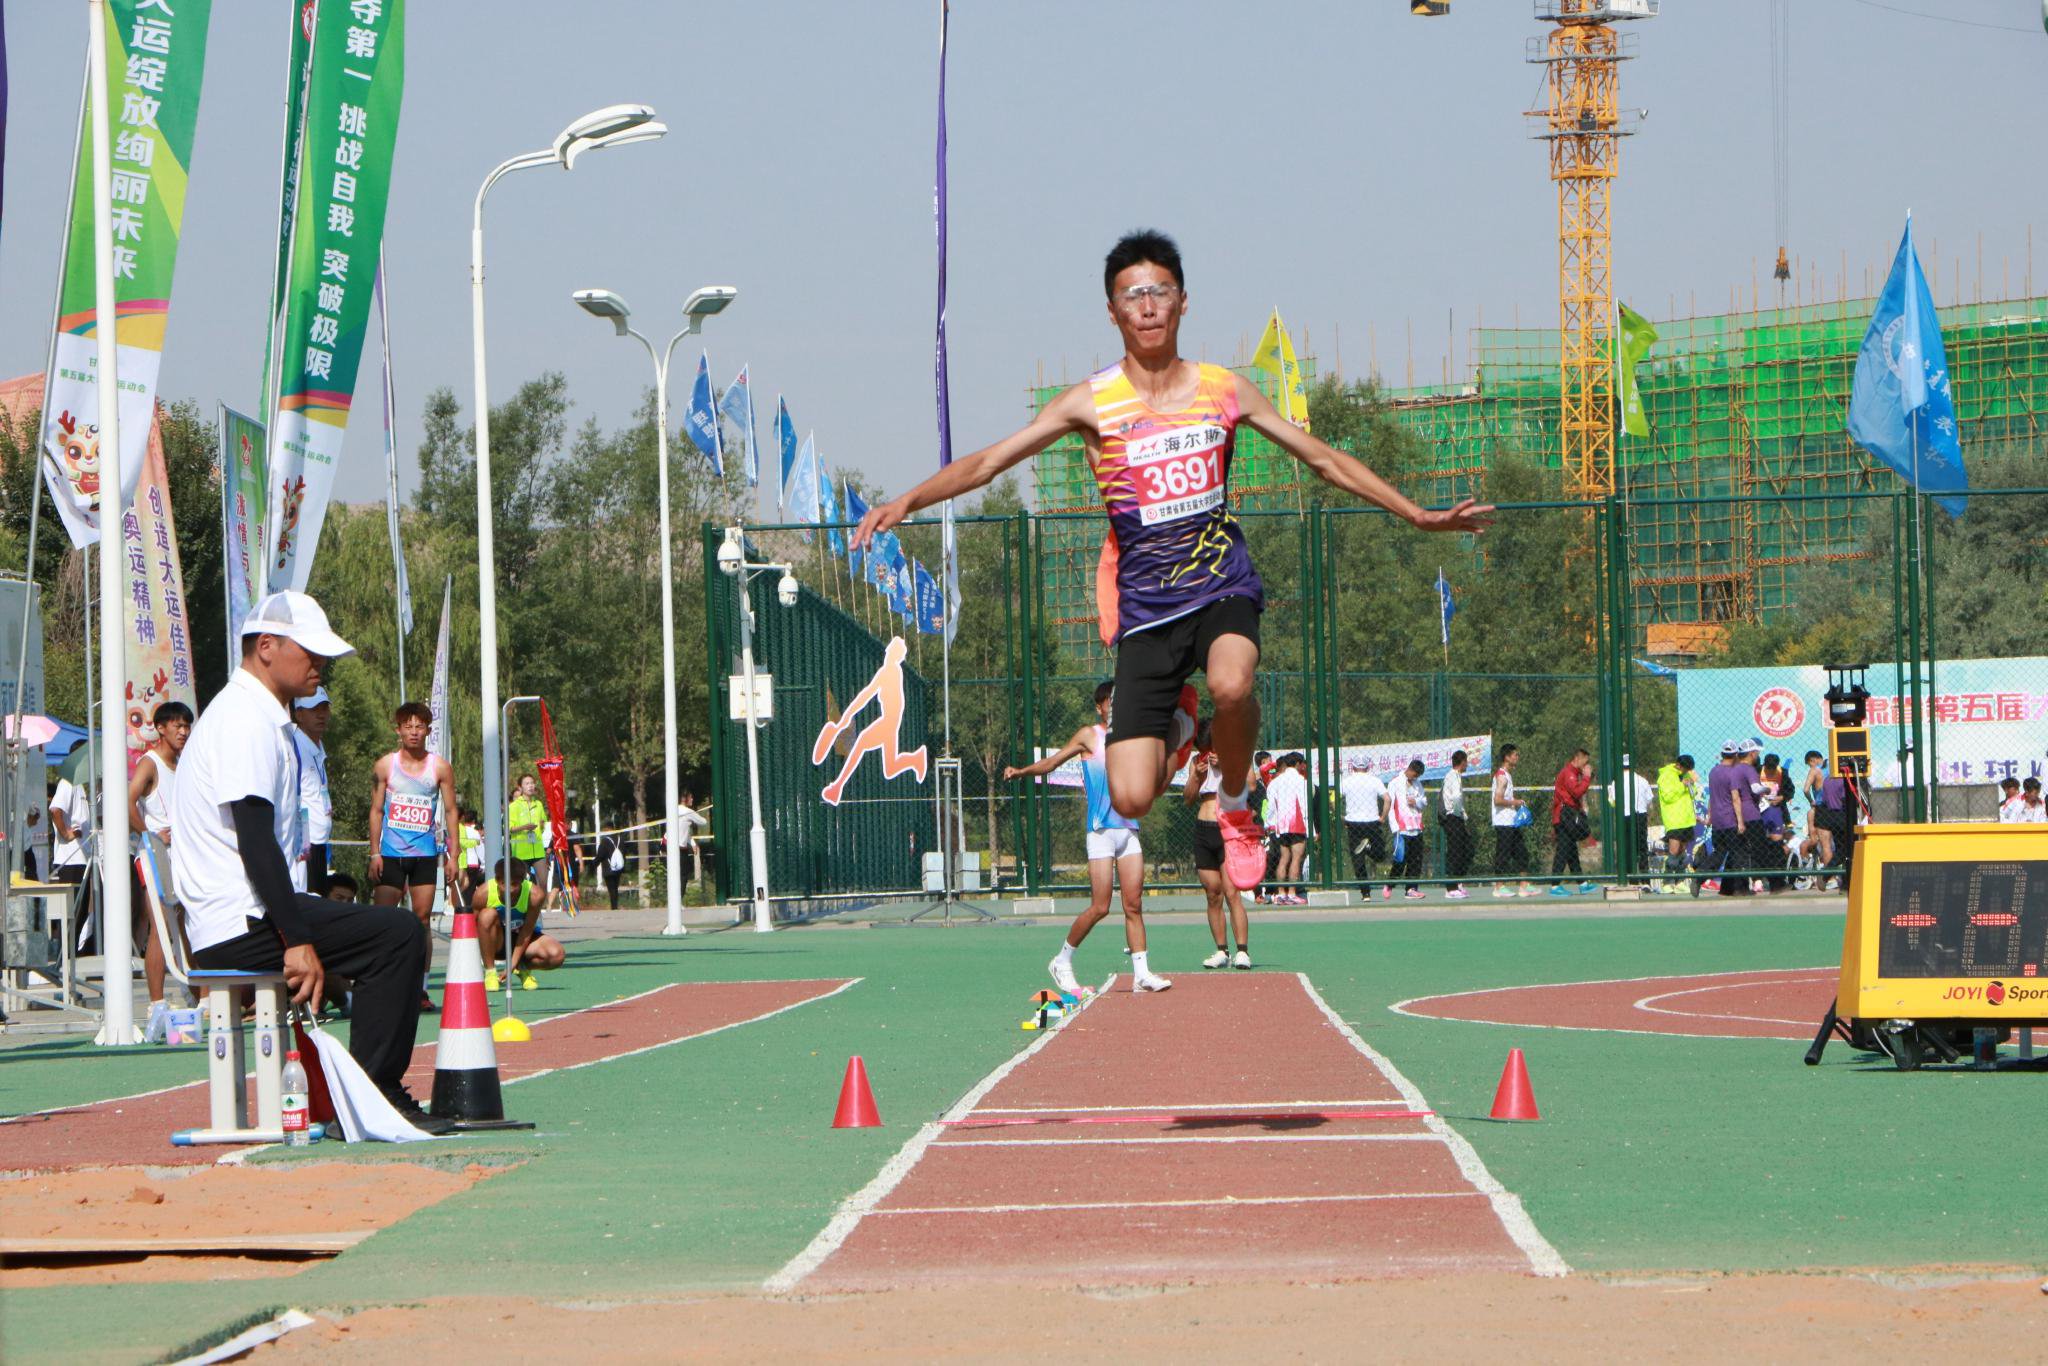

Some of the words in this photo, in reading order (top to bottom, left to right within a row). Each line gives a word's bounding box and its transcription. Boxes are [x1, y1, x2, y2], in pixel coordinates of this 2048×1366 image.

[328, 102, 368, 237] 挑战自我
[304, 248, 350, 382] 突破极限
[1143, 451, 1219, 500] 3691
[1164, 428, 1222, 453] 海尔斯
[123, 495, 156, 646] 奥运精神
[147, 484, 190, 689] 创造大运佳绩
[392, 805, 429, 824] 3490
[1943, 986, 1982, 1000] JOYI
[2009, 987, 2048, 1002] Spor
